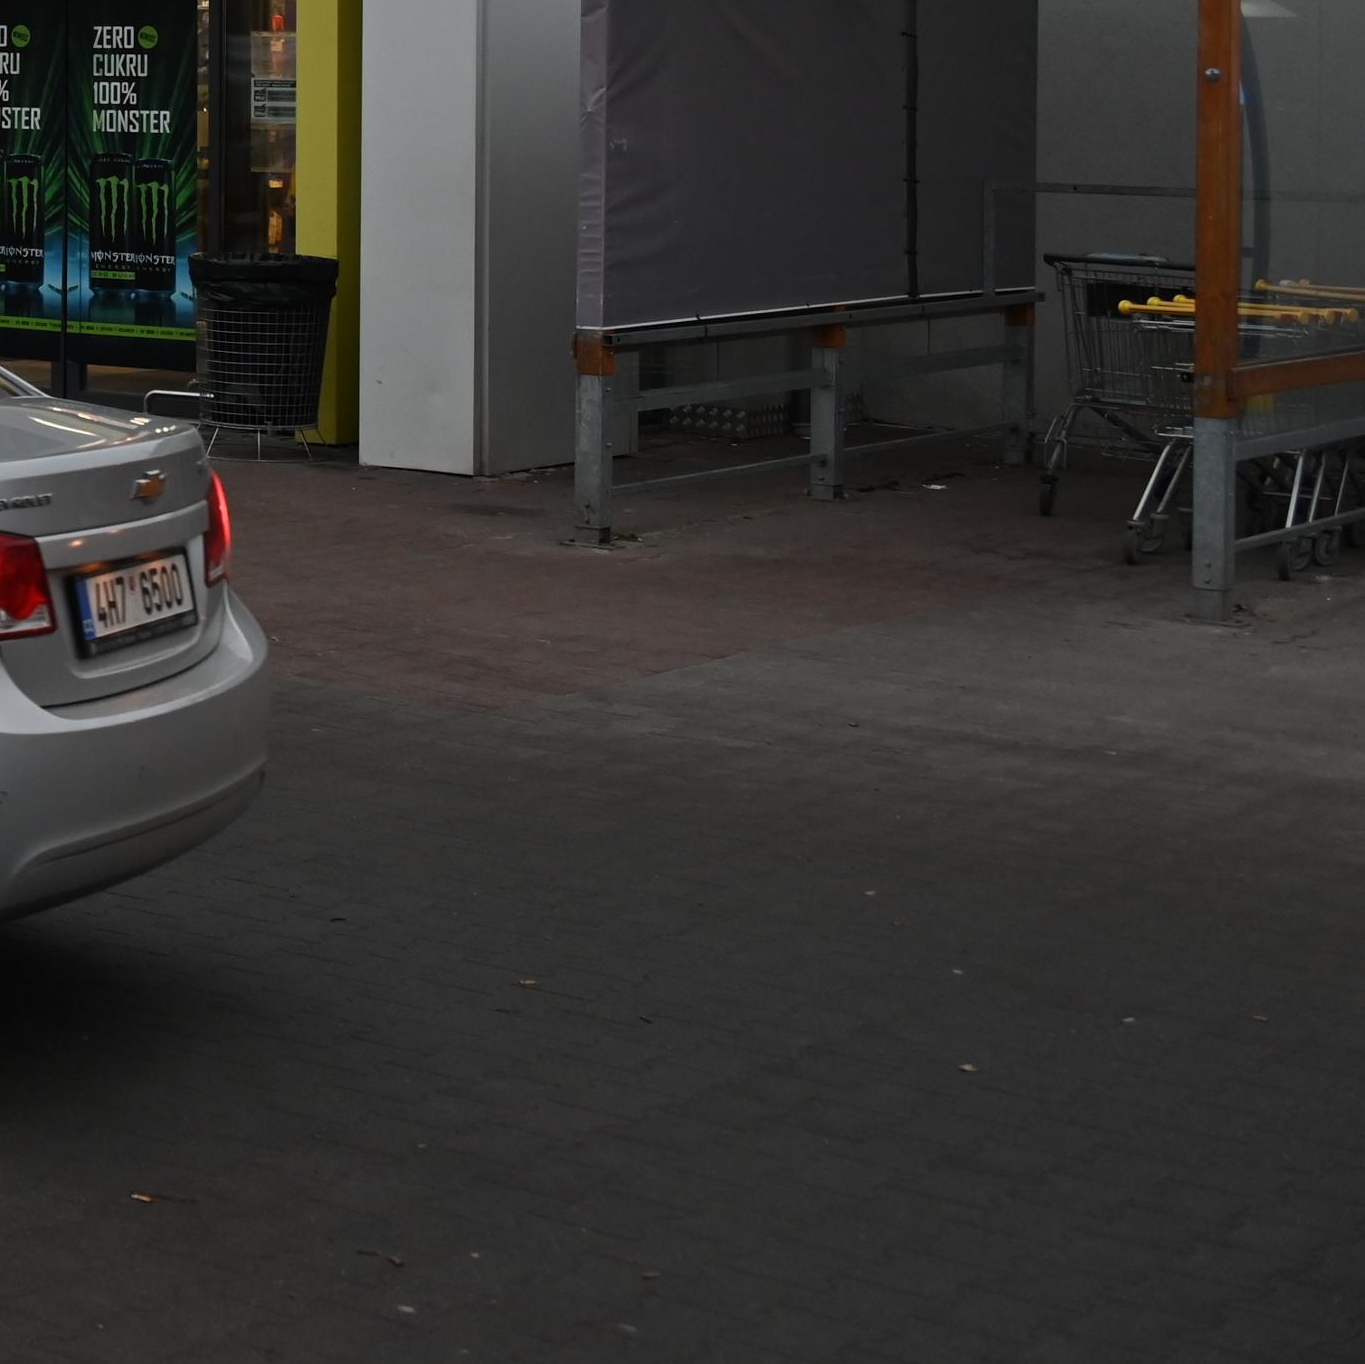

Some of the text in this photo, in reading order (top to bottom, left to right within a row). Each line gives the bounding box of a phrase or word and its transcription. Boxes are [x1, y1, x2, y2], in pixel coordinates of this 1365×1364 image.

[92, 25, 135, 50] ZERO
[92, 54, 149, 77] CUKRU
[93, 81, 138, 105] 100%
[92, 110, 171, 134] MONSTER
[95, 563, 184, 628] 4H7 6500
